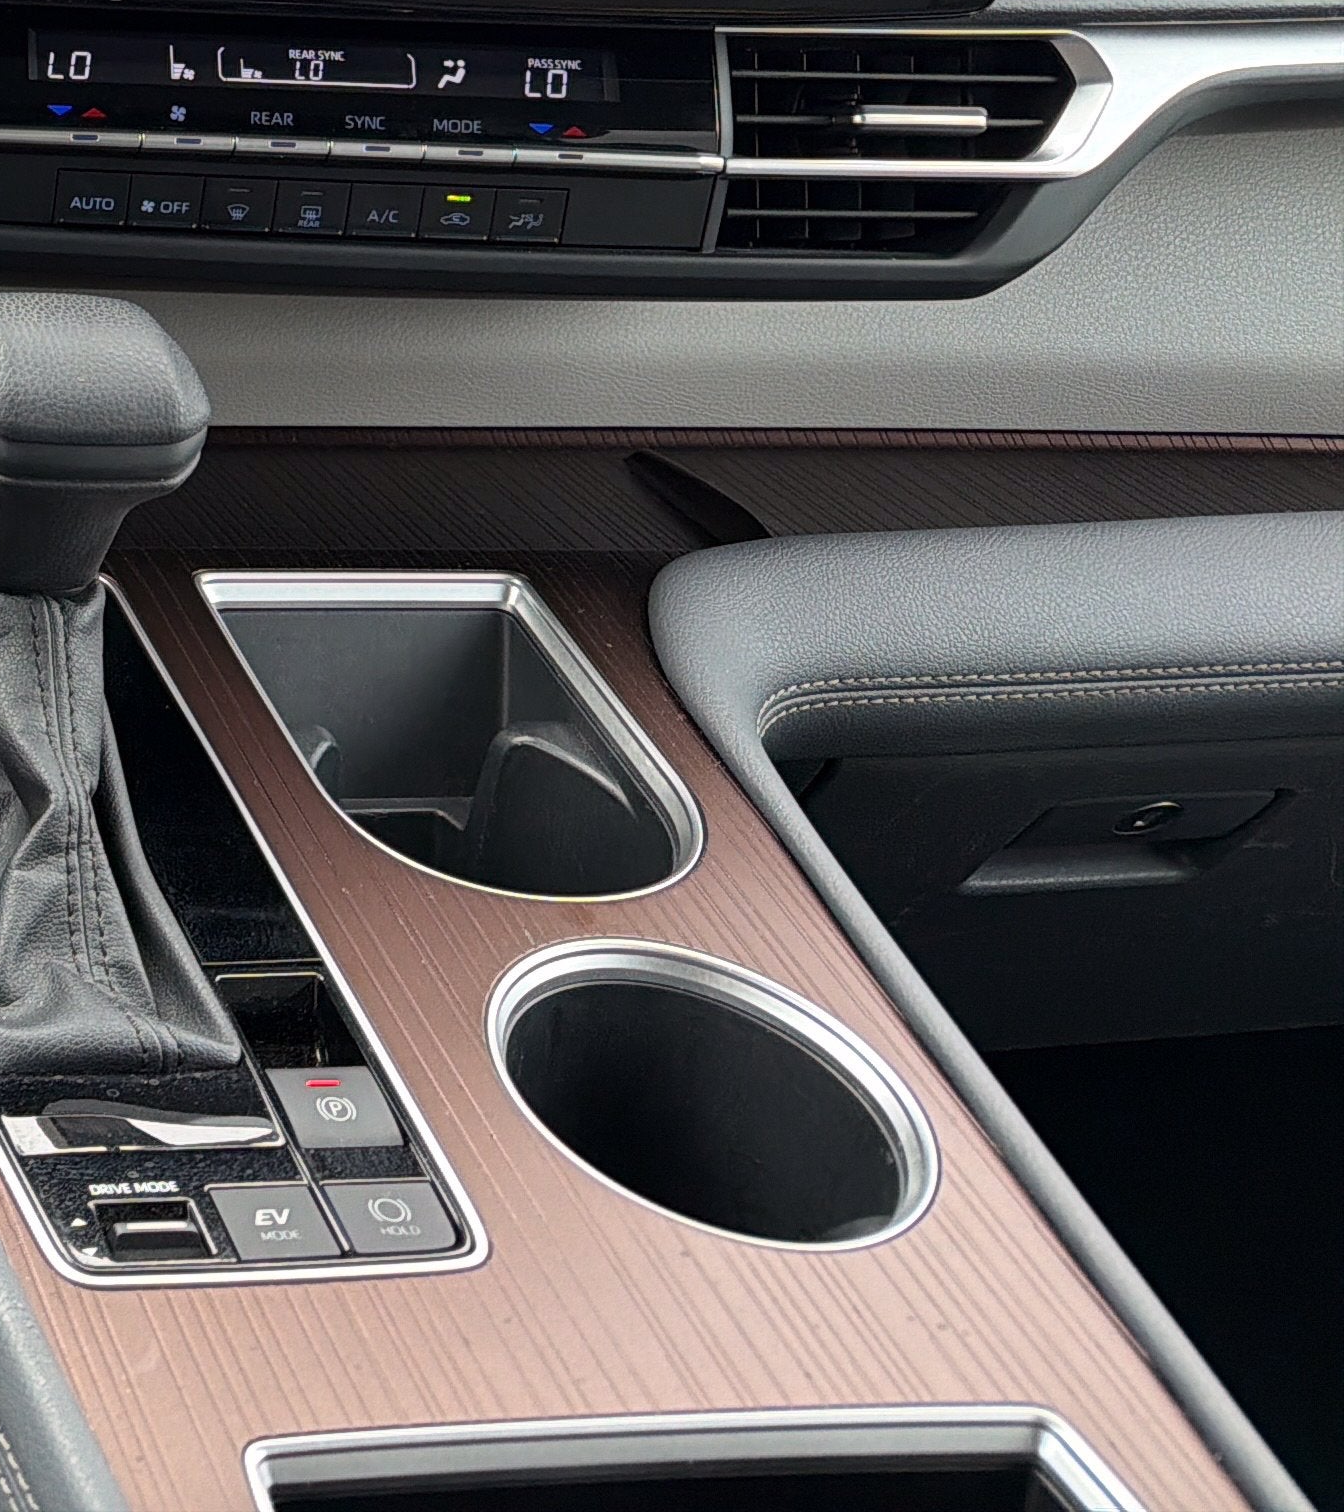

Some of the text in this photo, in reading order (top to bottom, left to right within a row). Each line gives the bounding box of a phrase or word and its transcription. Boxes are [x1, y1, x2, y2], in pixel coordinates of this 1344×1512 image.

[288, 49, 346, 62] REAR SYNC
[47, 51, 92, 80] LO
[295, 61, 324, 80] LO
[527, 58, 582, 71] PASS SYNC
[524, 69, 569, 99] LO
[251, 111, 294, 126] REAR
[345, 115, 386, 130] SYNC
[433, 119, 482, 134] MODE
[70, 197, 115, 211] AUTO
[160, 202, 190, 214] OFF
[297, 220, 320, 228] REAR
[367, 210, 400, 224] A/C
[88, 1180, 180, 1196] DRIVE MODE
[255, 1208, 290, 1226] EV
[261, 1229, 300, 1241] MODE
[380, 1226, 421, 1236] HOLD
